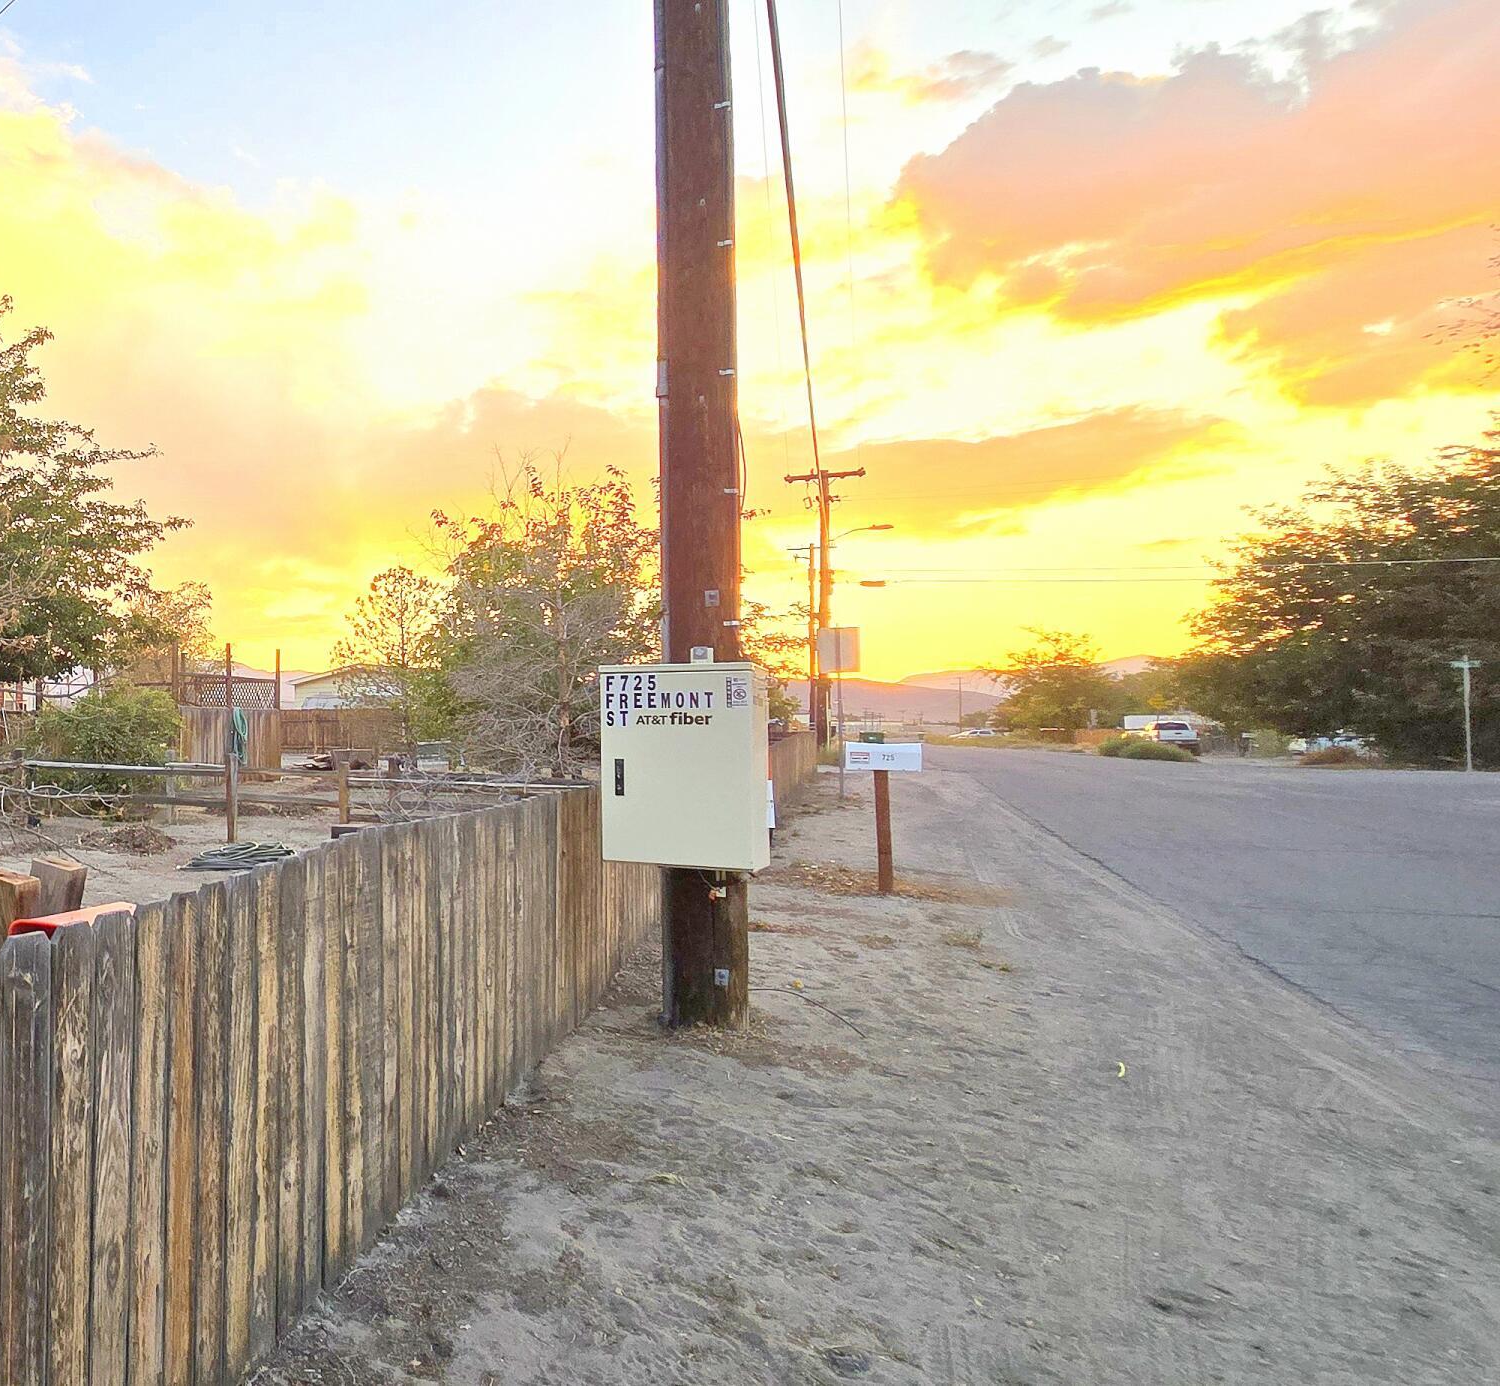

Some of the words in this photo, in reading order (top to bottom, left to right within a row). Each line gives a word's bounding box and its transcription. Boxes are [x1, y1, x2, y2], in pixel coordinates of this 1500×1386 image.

[606, 692, 713, 709] FREEMONT
[606, 711, 629, 726] ST
[636, 715, 668, 725] AT&T
[669, 712, 713, 725] fiber
